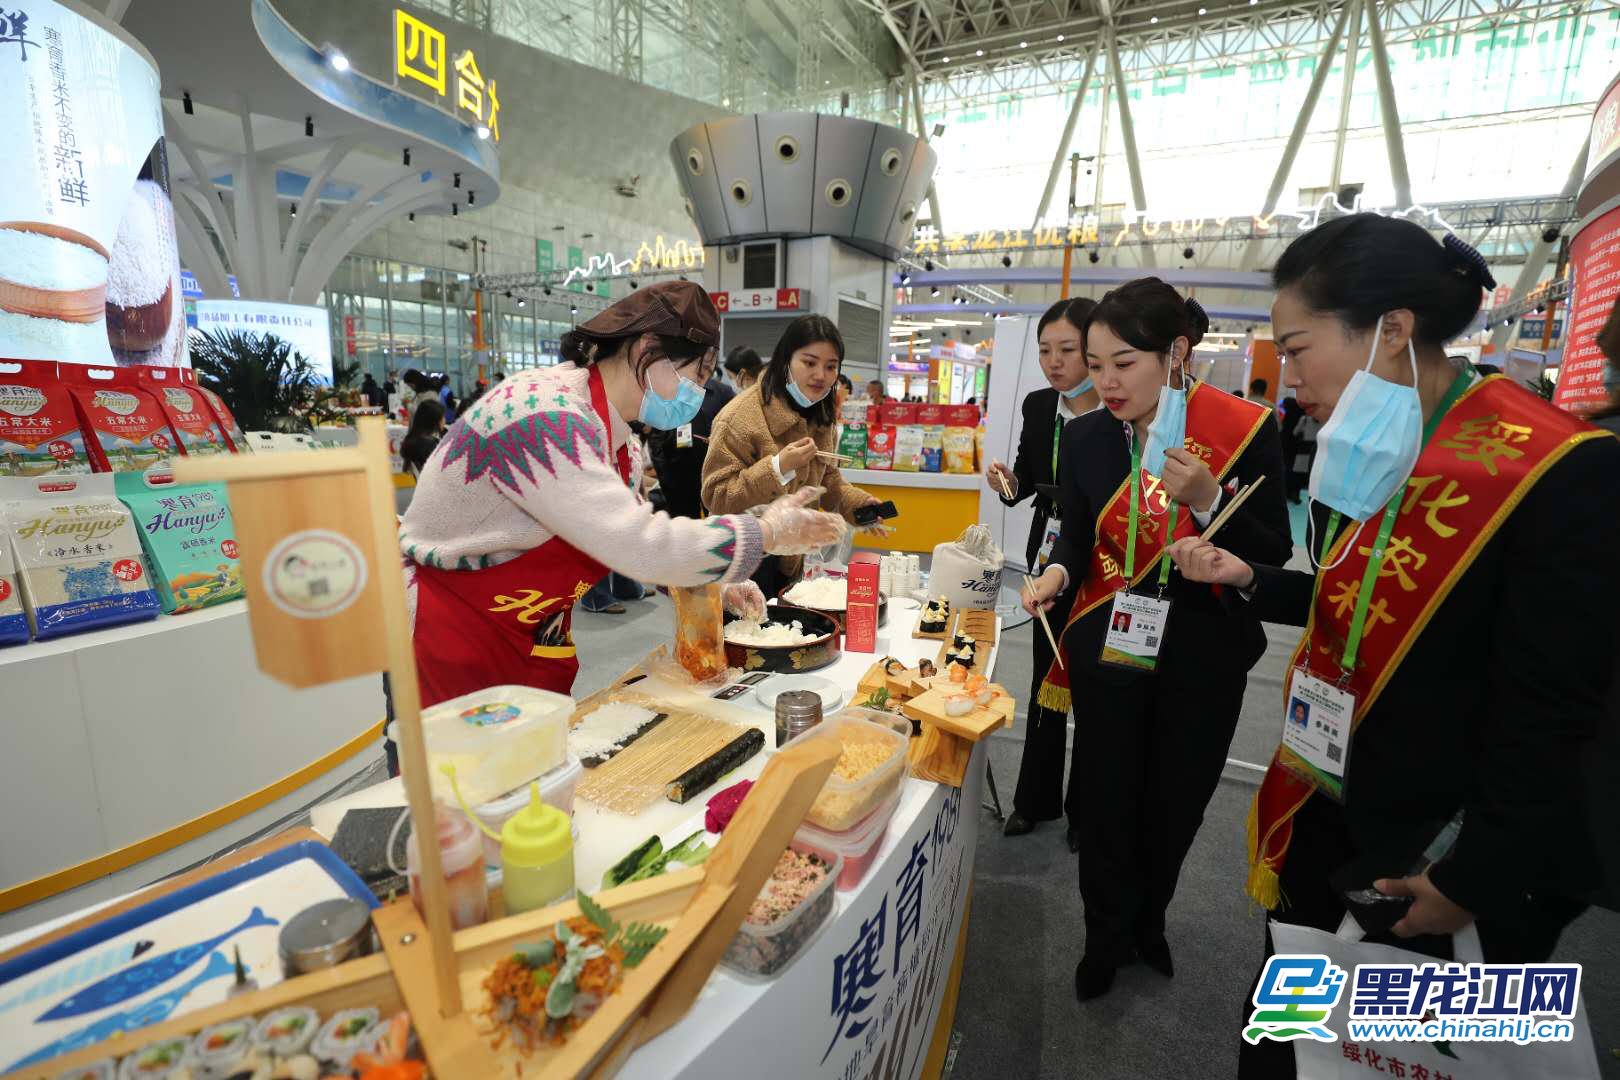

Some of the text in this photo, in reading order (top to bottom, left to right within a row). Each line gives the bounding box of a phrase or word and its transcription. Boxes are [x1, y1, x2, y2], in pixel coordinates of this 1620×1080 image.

[717, 291, 797, 308] C B A
[1523, 322, 1560, 332] 安全口
[16, 516, 116, 542] Hanyu
[145, 508, 217, 535] Hanyu
